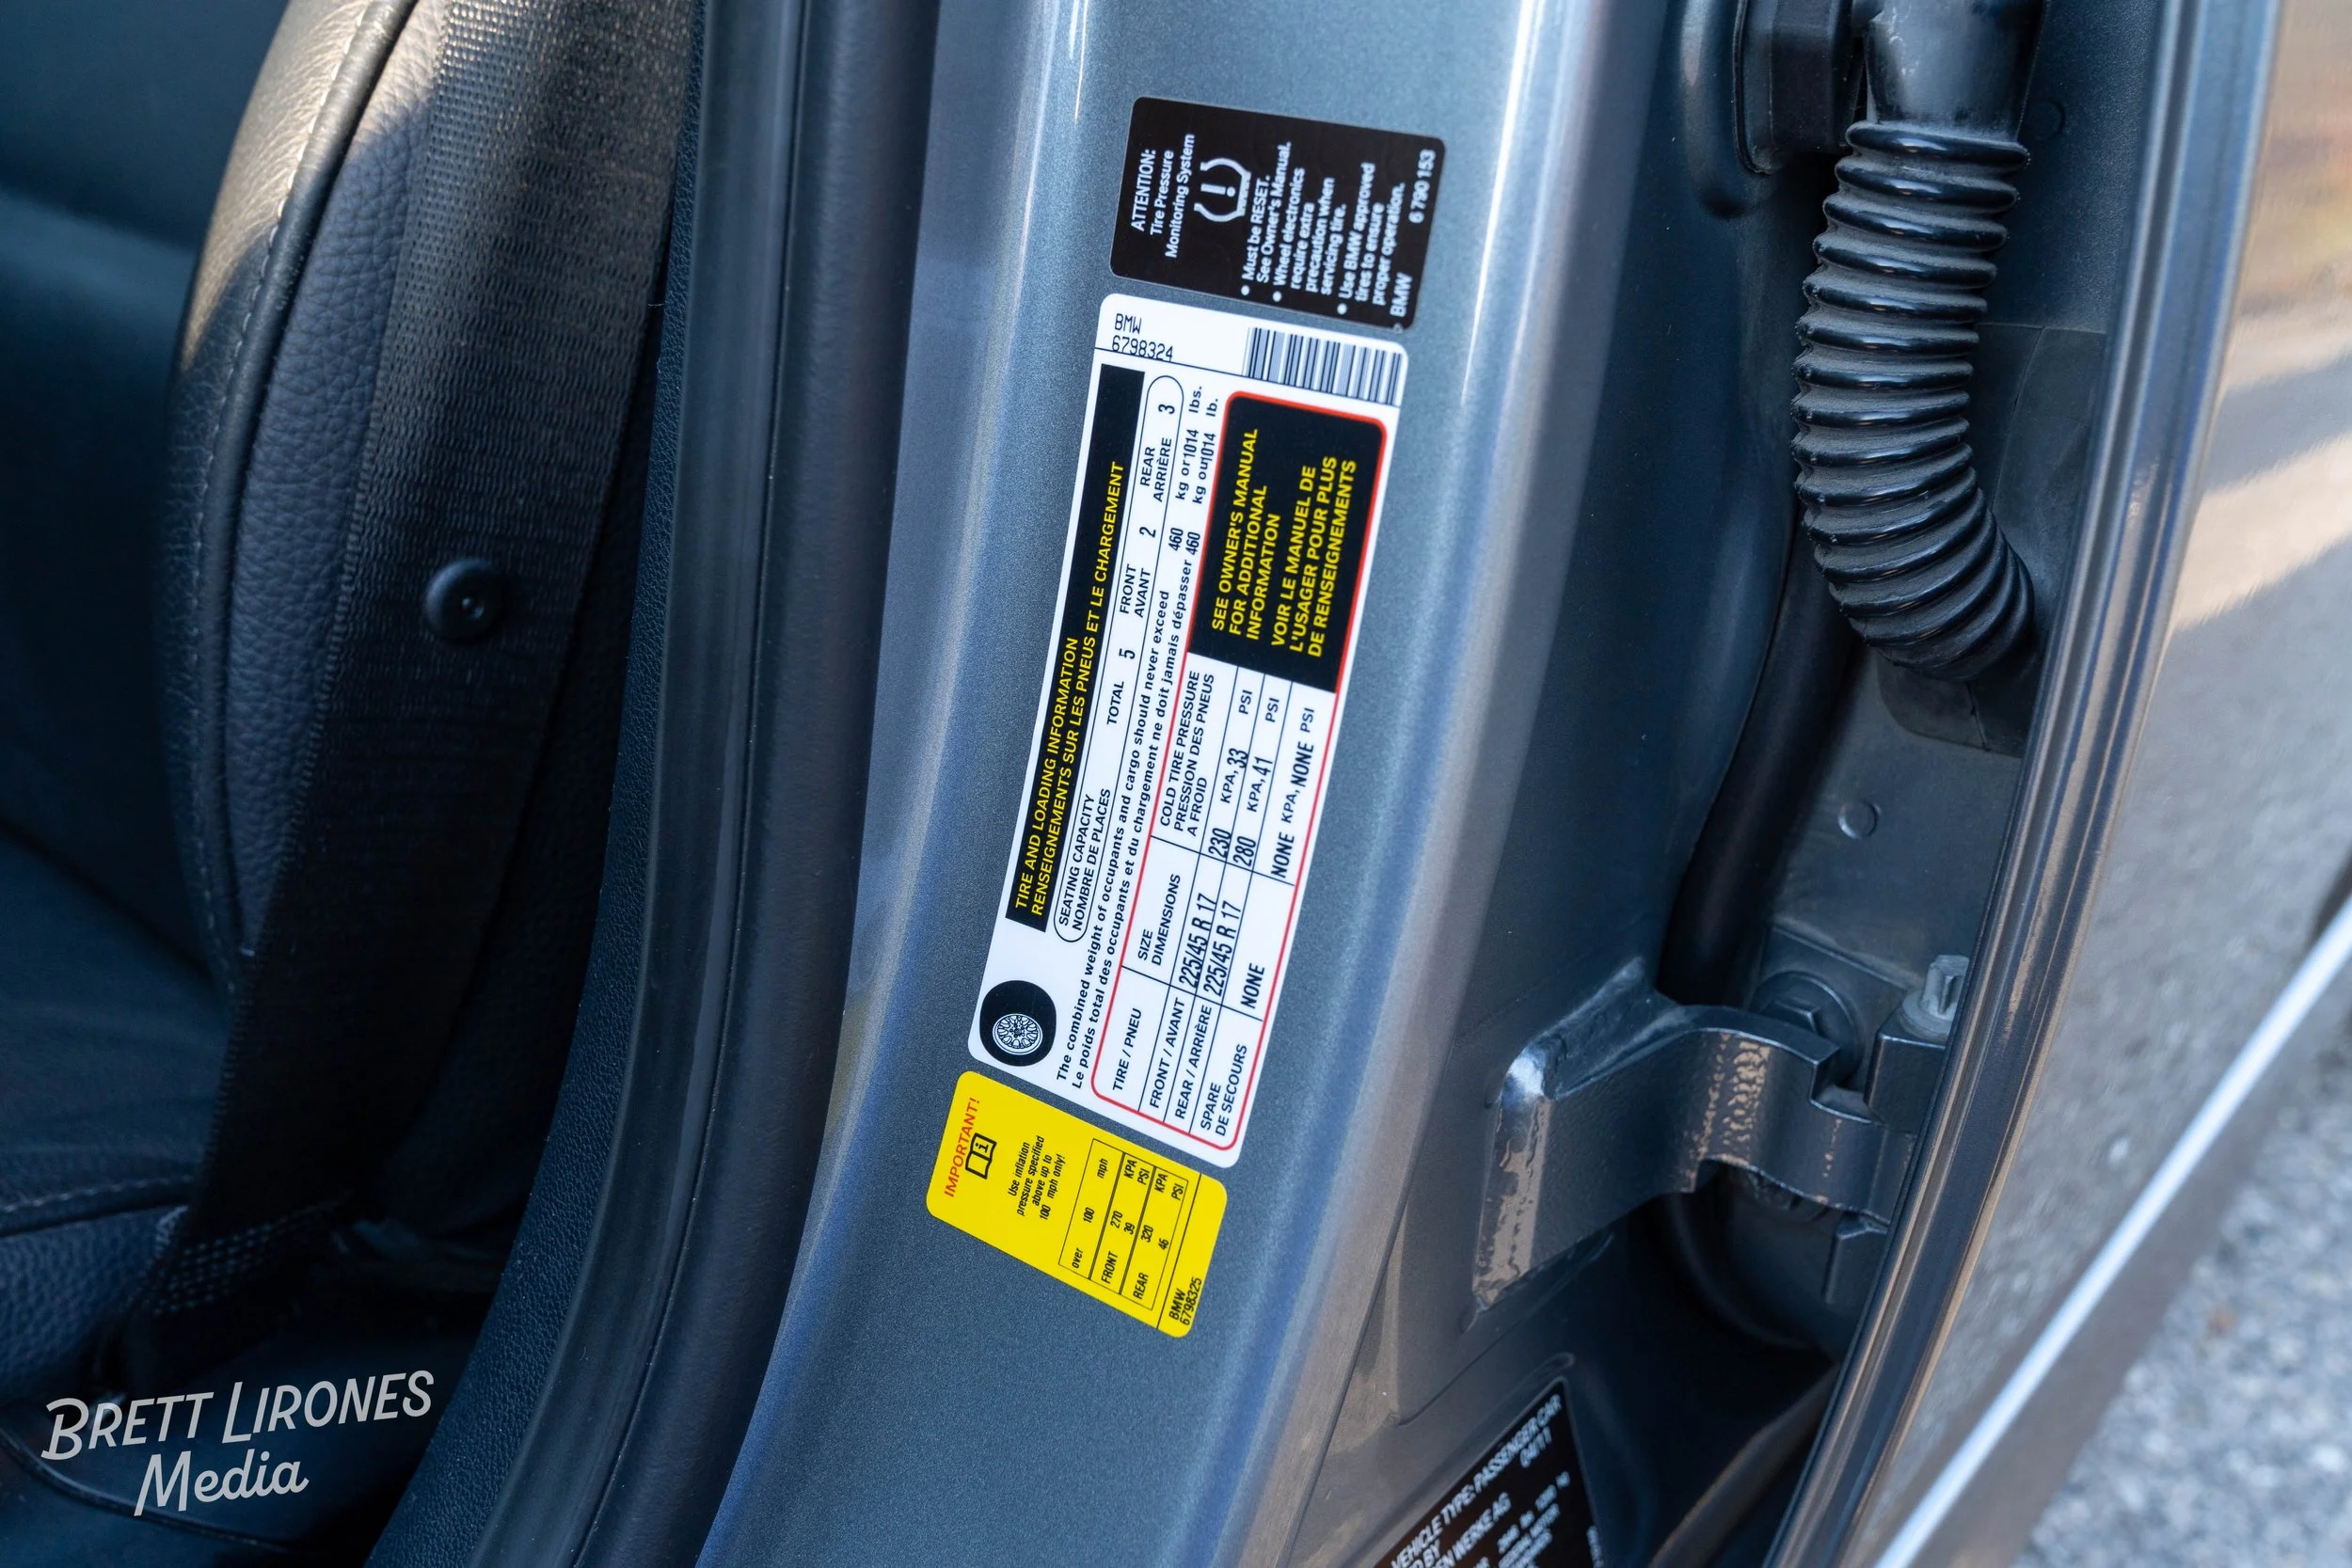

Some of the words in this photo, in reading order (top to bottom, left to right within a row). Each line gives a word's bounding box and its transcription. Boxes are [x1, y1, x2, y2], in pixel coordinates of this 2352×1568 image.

[1176, 134, 1195, 183] System
[1269, 142, 1291, 198] Manual.
[1131, 149, 1156, 231] ATTENTION:
[1153, 150, 1174, 208] Pressure
[1250, 175, 1270, 224] RESET.
[1281, 167, 1305, 243] electronics
[1150, 210, 1165, 235] Tire
[1165, 185, 1189, 258] Monitoring
[1247, 226, 1262, 245] be
[1261, 198, 1281, 255] Owner's
[1299, 202, 1314, 239] extra
[1305, 218, 1327, 293] precaution
[1318, 178, 1334, 216] when
[1241, 245, 1259, 280] Must
[1256, 257, 1272, 283] See
[1273, 244, 1292, 286] Wheel
[1291, 240, 1308, 290] require
[1390, 273, 1412, 317] BMW
[1115, 313, 1142, 334] BMW
[1111, 336, 1173, 361] 6798324
[1157, 404, 1175, 415] 3
[1188, 386, 1202, 413] lbs.
[1205, 399, 1218, 417] lb.
[1183, 429, 1199, 458] 1014
[1200, 433, 1216, 461] 1014
[1139, 447, 1155, 486] REAR
[1152, 437, 1172, 502] ARRIÈRE
[1232, 429, 1258, 507] MANUAL
[1299, 466, 1316, 492] DE
[1316, 456, 1337, 504] PLUS
[1175, 482, 1189, 500] kg
[1192, 485, 1206, 504] kg
[1094, 461, 1123, 582] CHARGEMENT
[1138, 526, 1156, 538] 2
[1168, 527, 1184, 551] 460
[1236, 485, 1267, 595] ADDITIONAL
[1284, 497, 1311, 574] MANUEL
[1306, 508, 1327, 560] POUR
[1185, 531, 1200, 555] 460
[1218, 511, 1244, 593] OWNER'S
[1313, 460, 1356, 628] RENSEIGNEMENTS
[1089, 586, 1104, 607] LE
[1119, 563, 1136, 614] FRONT
[1134, 567, 1151, 618] AVANT
[1171, 559, 1192, 629] dépasser
[1246, 514, 1280, 640] INFORMATION
[1279, 578, 1296, 600] LE
[1086, 610, 1100, 632] ET
[1152, 590, 1169, 643] exceed
[1212, 596, 1229, 630] SEE
[1229, 599, 1247, 635] FOR
[1271, 604, 1291, 645] VOIR
[1289, 563, 1318, 652] L'USAGER
[1161, 634, 1179, 686] jamais
[1308, 631, 1325, 657] DE
[1075, 636, 1095, 692] PNEUS
[1144, 647, 1159, 690] never
[1046, 637, 1078, 754] INFORMATION
[1106, 681, 1124, 725] TOTAL
[1118, 648, 1136, 659] 5
[1155, 687, 1169, 718] doit
[1196, 673, 1214, 723] PNEUS
[1238, 689, 1252, 715] PSI
[1069, 695, 1085, 726] LES
[1133, 694, 1151, 745] should
[1264, 697, 1279, 722] PSI
[1062, 730, 1079, 764] SUR
[1152, 722, 1163, 741] ne
[1160, 786, 1176, 826] COLD
[1168, 750, 1184, 783] TIRE
[1176, 671, 1200, 747] PRESSURE
[1189, 726, 1204, 756] DES
[1125, 750, 1140, 791] cargo
[1226, 748, 1248, 768] 33
[1252, 756, 1273, 776] 41
[1032, 758, 1057, 831] LOADING
[1133, 744, 1158, 833] chargement
[1173, 758, 1198, 832] PRESSION
[1189, 777, 1207, 822] FROID
[1219, 770, 1238, 803] KPA,
[1247, 779, 1265, 813] KPA,
[1091, 788, 1110, 843] PLACES
[1119, 795, 1131, 823] and
[1031, 767, 1072, 915] RENSEIGNEMENTS
[1127, 837, 1139, 856] du
[1186, 826, 1198, 837] A
[1208, 828, 1231, 859] 230
[1232, 835, 1256, 867] 280
[1025, 834, 1041, 870] AND
[1058, 865, 1080, 926] SEATING
[1073, 794, 1094, 863] CAPACITY
[1086, 845, 1099, 865] DE
[1102, 827, 1124, 902] occupants
[1124, 860, 1135, 876] et
[1015, 872, 1033, 908] TIRE
[1072, 867, 1094, 931] NOMBRE
[1196, 893, 1216, 911] 17
[1220, 900, 1241, 919] 17
[1097, 904, 1107, 922] of
[1106, 879, 1130, 955] occupants
[1151, 874, 1181, 966] DIMENSIONS
[1191, 917, 1211, 931] R
[1216, 925, 1236, 939] R
[1084, 925, 1103, 975] weight
[1137, 928, 1153, 960] SIZE
[1178, 933, 1207, 989] 225/45
[1098, 958, 1112, 985] des
[1202, 941, 1232, 997] 225/45
[1240, 962, 1264, 1009] NONE
[1067, 979, 1090, 1051] combined
[1089, 988, 1104, 1023] total
[1056, 1054, 1072, 1080] The
[1079, 1027, 1095, 1069] poids
[1112, 1058, 1129, 1090] TIRE
[1123, 1007, 1141, 1048] PNEU
[1149, 1057, 1169, 1108] FRONT
[1165, 997, 1184, 1048] AVANT
[1174, 1080, 1194, 1119] REAR
[1188, 1005, 1212, 1069] ARRIÈRE
[1072, 1071, 1084, 1089] Le
[1221, 1044, 1248, 1114] SECOURS
[1200, 1082, 1221, 1131] SPARE
[1215, 1115, 1229, 1136] DE
[944, 1098, 979, 1197] IMPORTANT!
[1042, 1154, 1052, 1164] to
[1007, 1180, 1020, 1196] Use
[1014, 1142, 1030, 1178] inflation
[1016, 1178, 1033, 1217] pressure
[1027, 1134, 1044, 1177] specified
[1039, 1204, 1051, 1220] 100
[1046, 1179, 1058, 1199] mph
[1053, 1153, 1066, 1178] only!
[1040, 1165, 1050, 1178] up
[1031, 1180, 1045, 1206] above
[1109, 1210, 1123, 1228] 270
[1123, 1222, 1136, 1235] 39
[1140, 1225, 1153, 1243] 320
[1158, 1238, 1169, 1250] 46
[1101, 1250, 1118, 1284] FRONT
[1133, 1272, 1149, 1300] REAR
[1168, 1288, 1185, 1321] BMW
[1179, 1276, 1202, 1326] 6798325
[1391, 1514, 1444, 1568] VEHICLE
